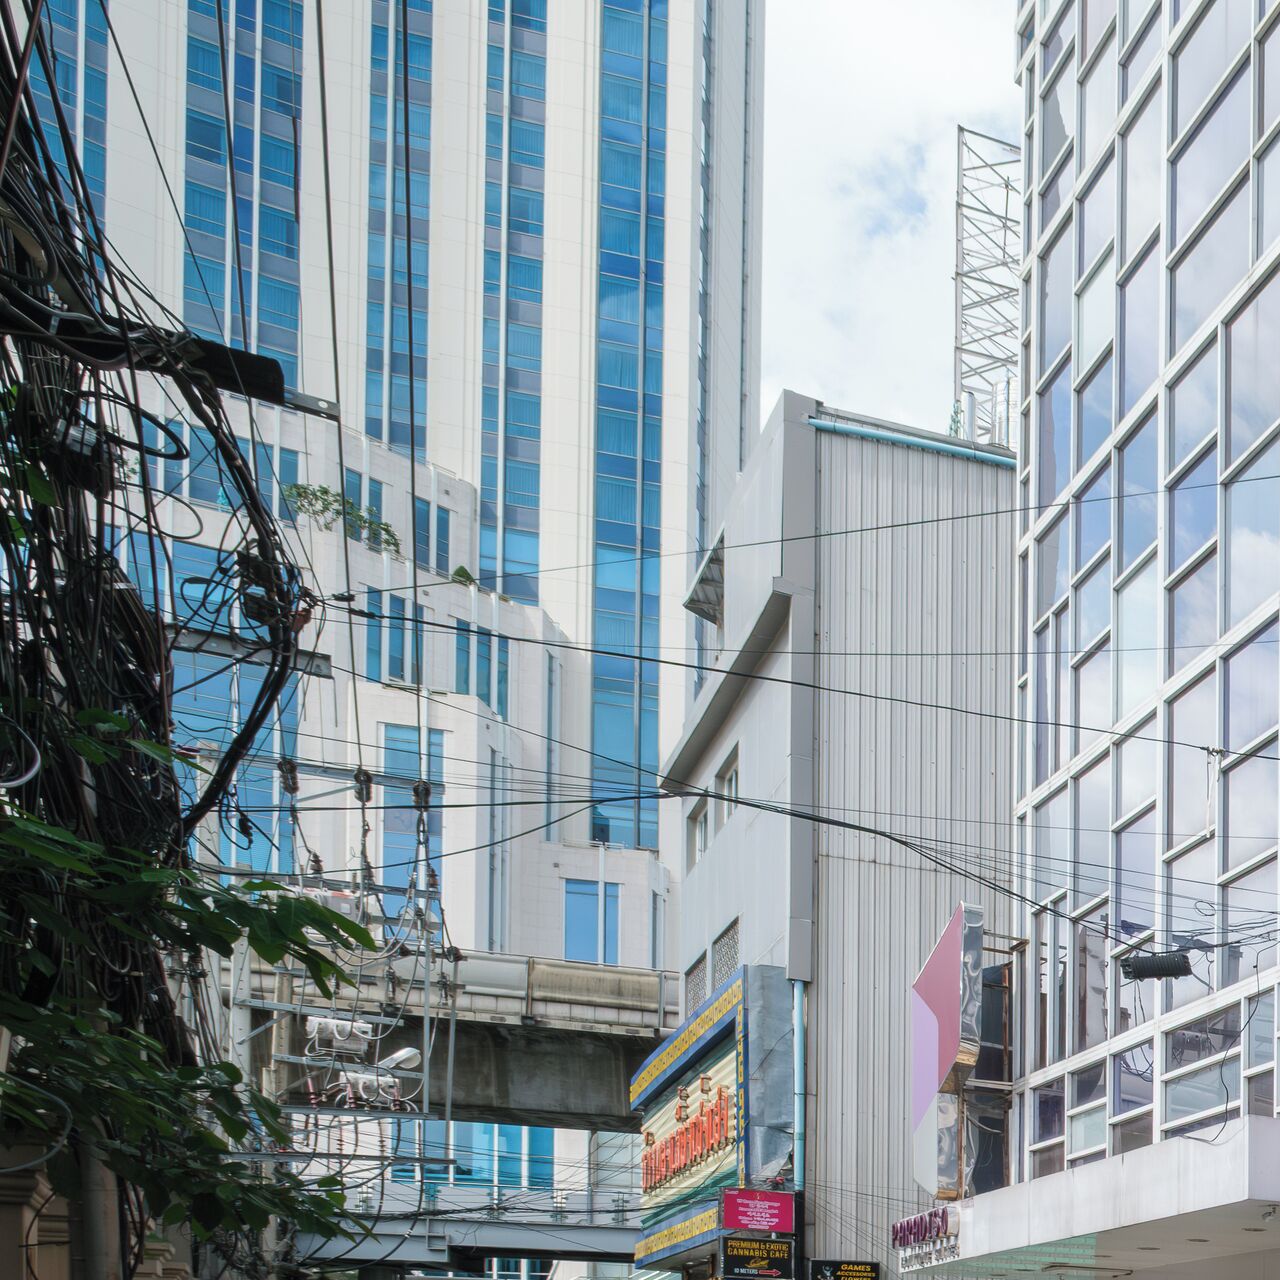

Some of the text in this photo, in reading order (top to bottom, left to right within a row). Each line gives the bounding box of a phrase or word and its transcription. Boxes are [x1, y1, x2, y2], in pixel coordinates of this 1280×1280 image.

[727, 1240, 759, 1249] PREMIUM
[766, 1243, 789, 1251] EXOTIC
[727, 1247, 767, 1258] CANNABIS
[841, 1264, 871, 1272] GAMES
